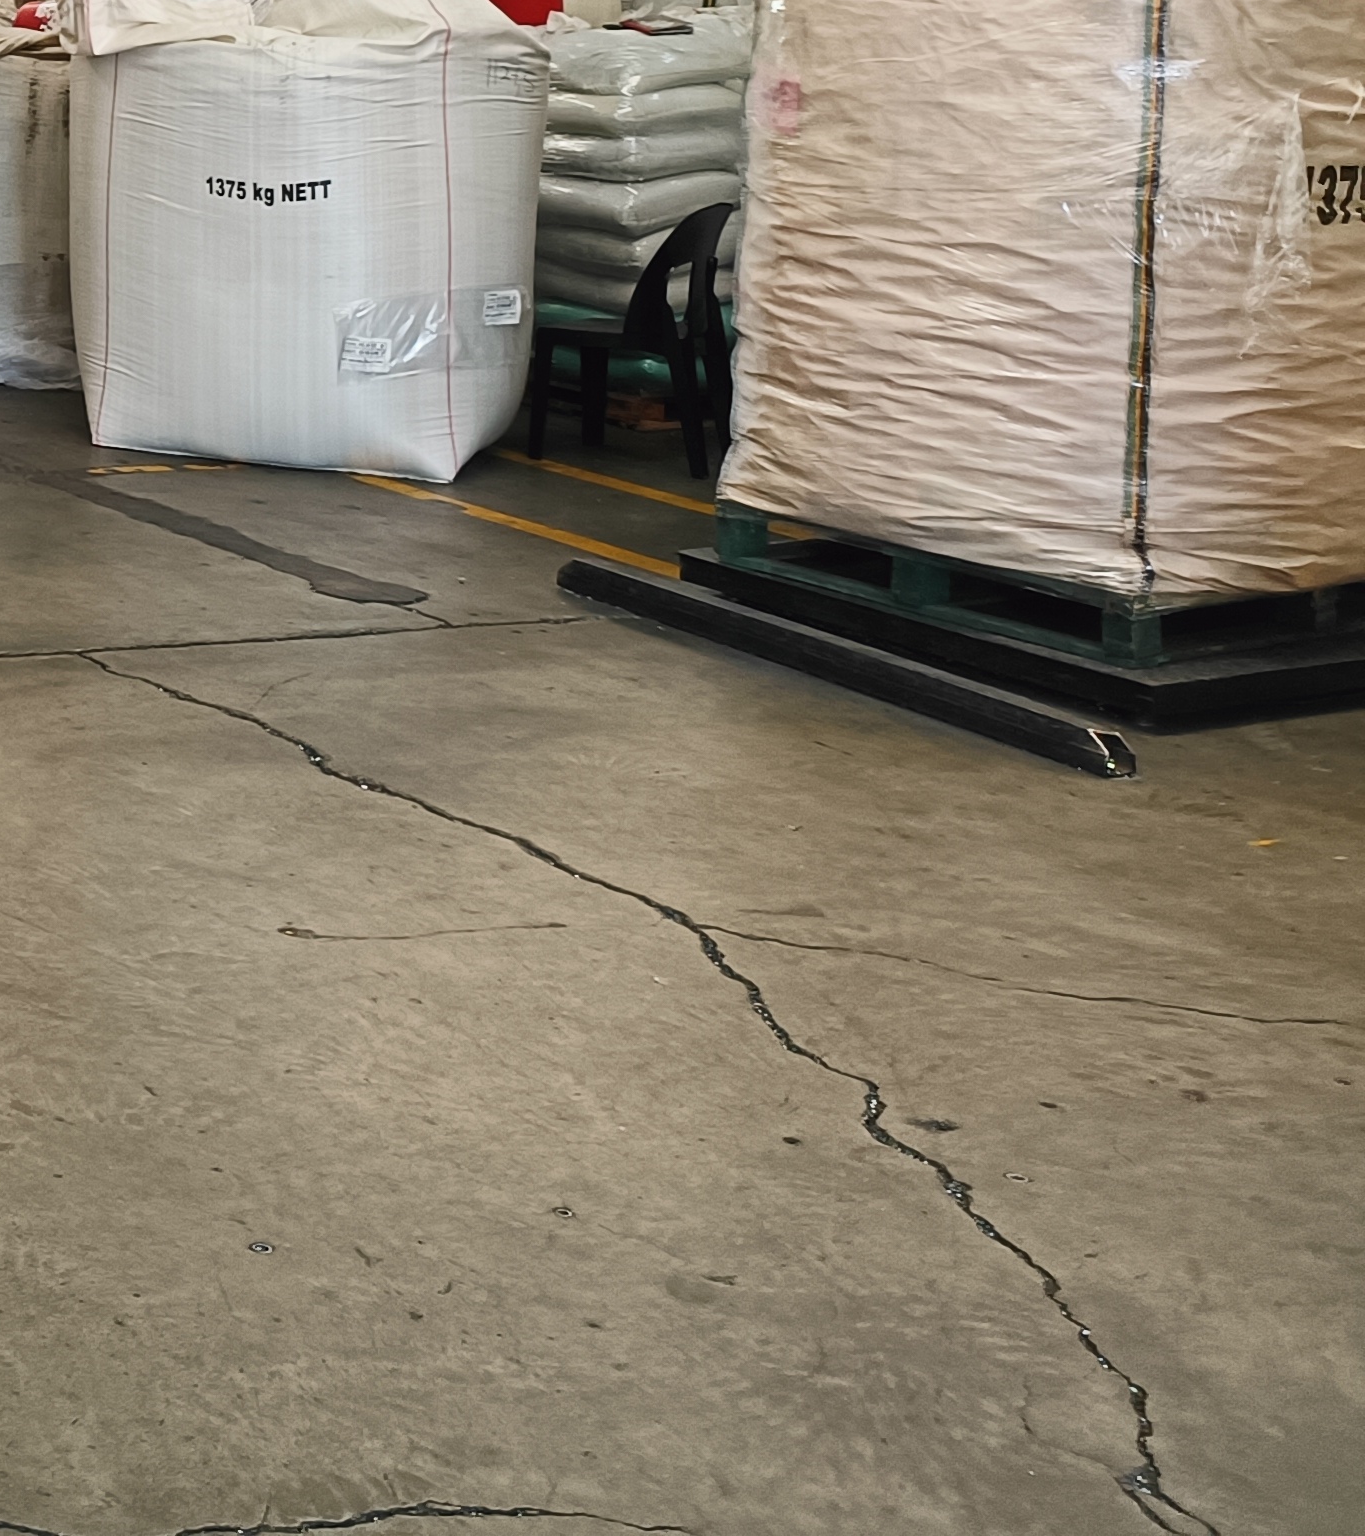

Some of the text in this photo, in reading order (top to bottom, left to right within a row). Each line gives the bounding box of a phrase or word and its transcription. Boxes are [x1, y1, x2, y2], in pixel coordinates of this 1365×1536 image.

[206, 176, 332, 206] 1375 kg NETT
